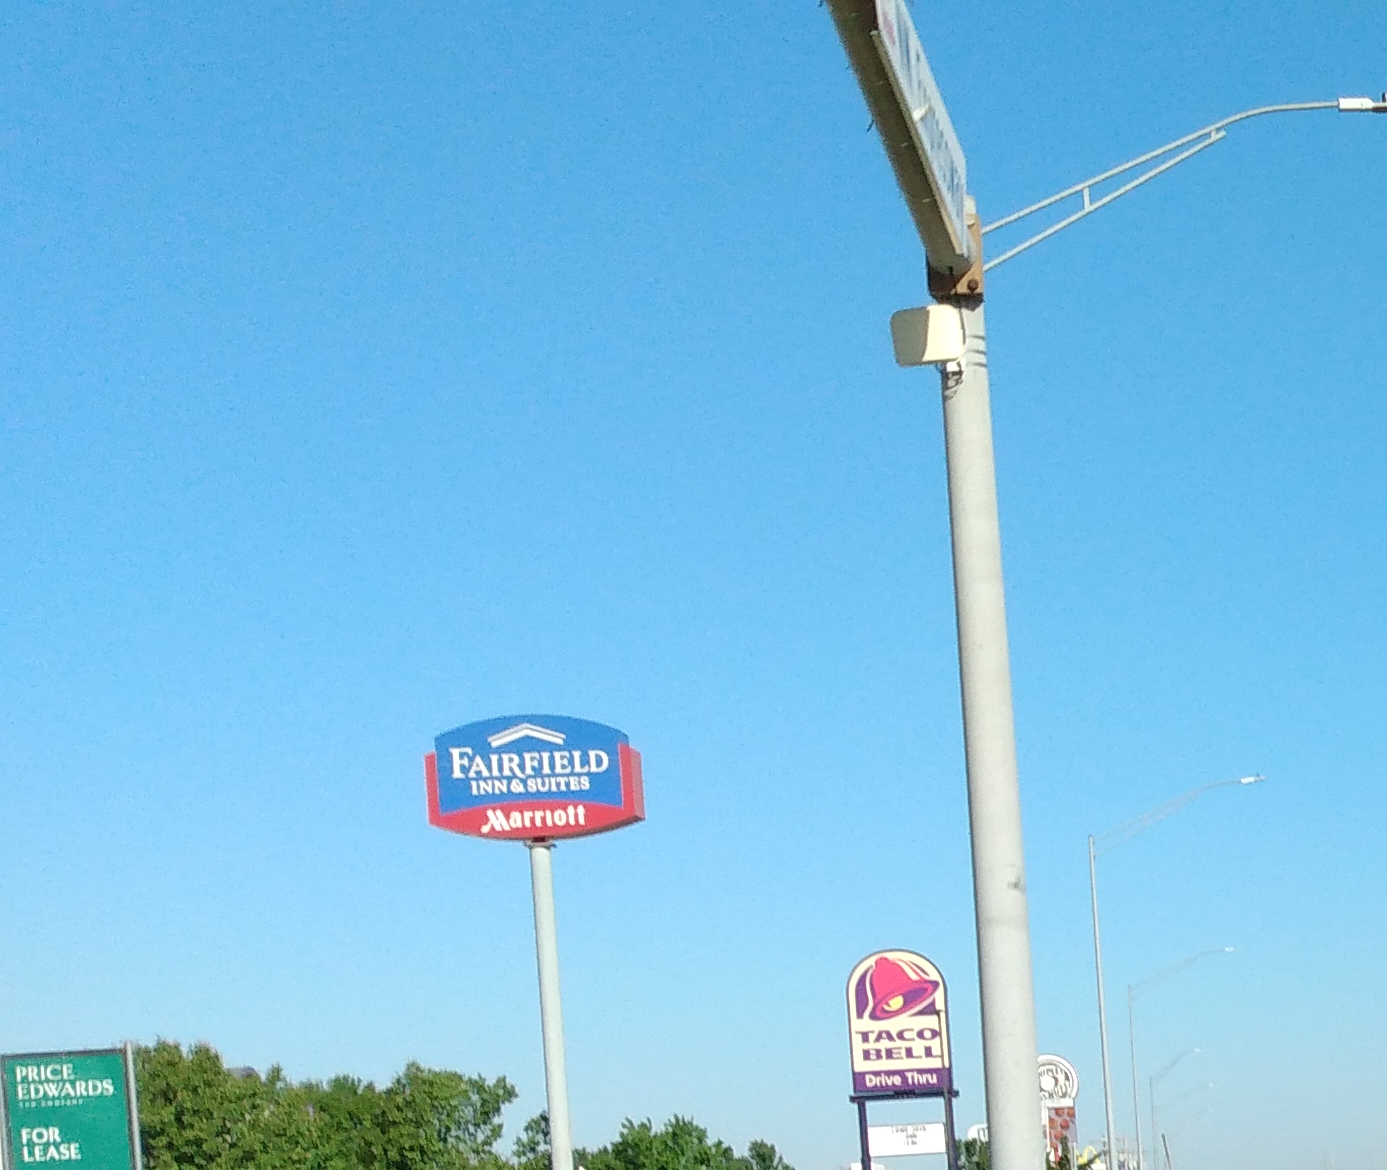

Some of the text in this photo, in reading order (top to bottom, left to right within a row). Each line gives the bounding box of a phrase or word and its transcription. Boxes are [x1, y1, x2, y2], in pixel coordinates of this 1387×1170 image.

[449, 747, 609, 779] FAIRFIELD
[471, 775, 590, 796] INN & SUITES
[480, 804, 586, 834] Marriott
[855, 1027, 939, 1044] TACO
[862, 1045, 941, 1062] BELL
[16, 1063, 75, 1082] PRICE
[865, 1071, 938, 1088] Drive Thru
[17, 1078, 115, 1100] EDWARDS
[21, 1126, 61, 1145] FOR
[23, 1142, 82, 1163] LEASE
